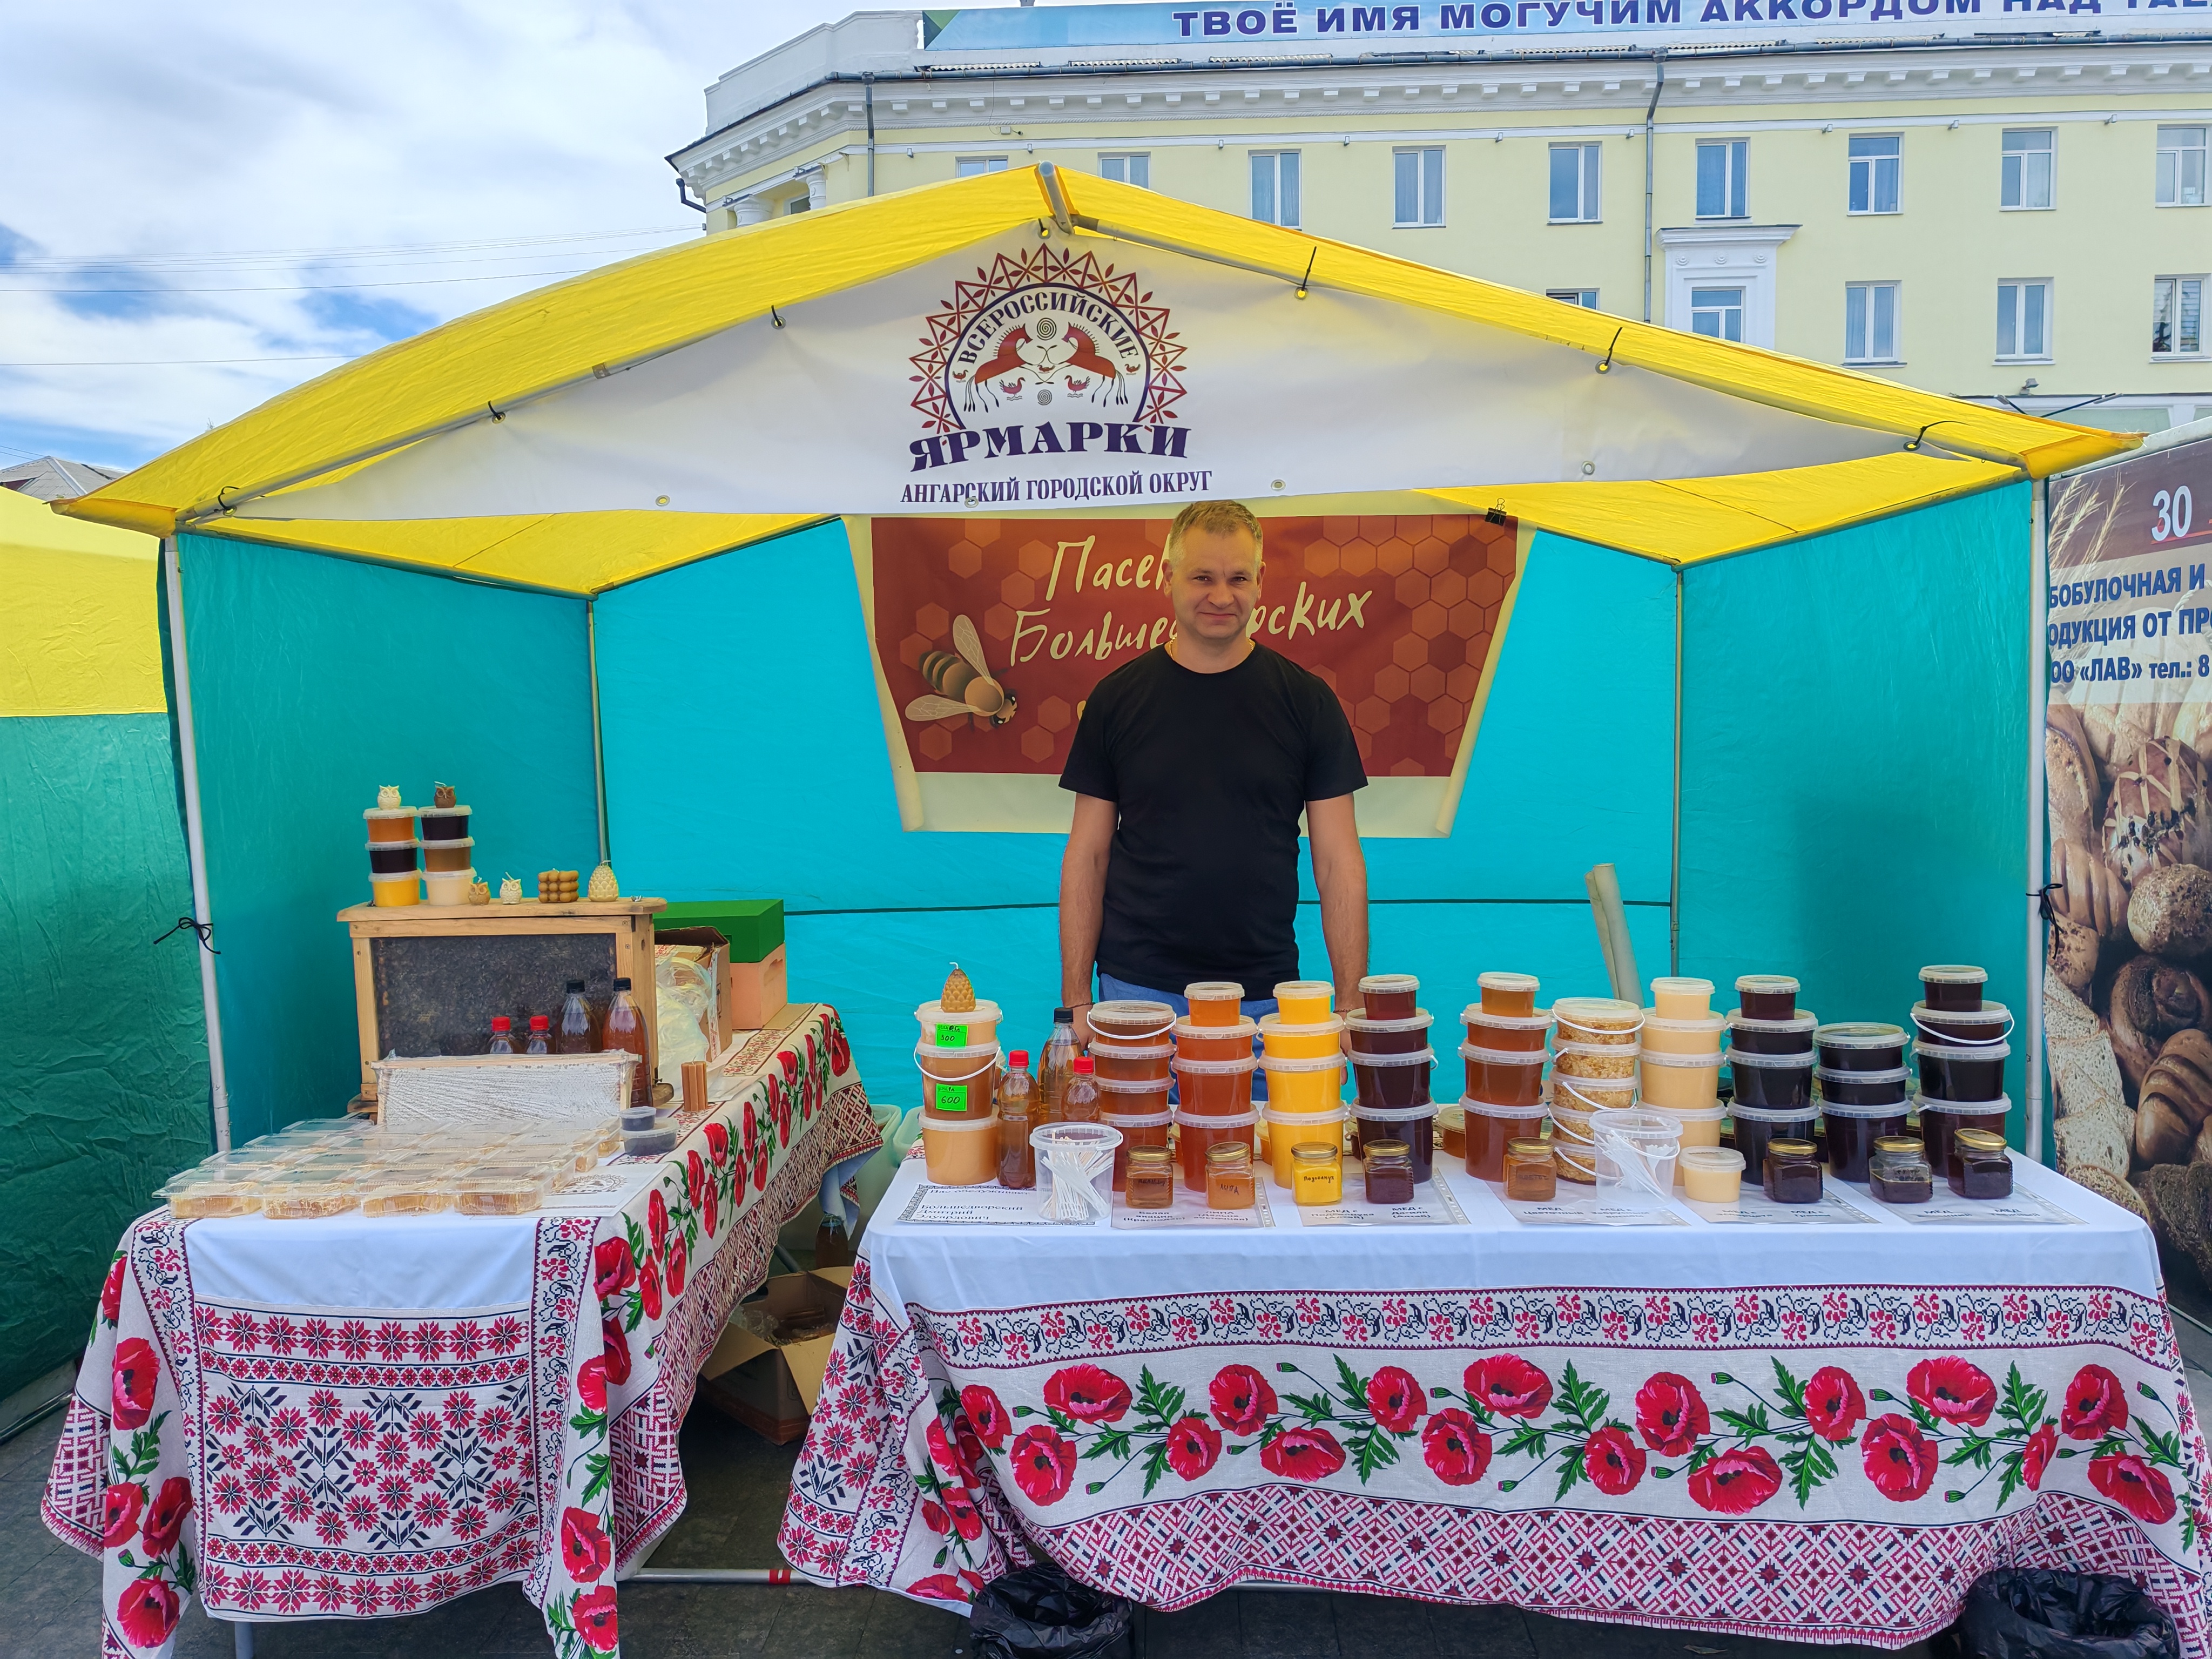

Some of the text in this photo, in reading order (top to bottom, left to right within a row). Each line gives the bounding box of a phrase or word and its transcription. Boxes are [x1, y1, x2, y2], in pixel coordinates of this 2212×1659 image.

[1173, 2, 1297, 37] ТВОЁ
[1316, 5, 1419, 32] ИМЯ
[1440, 0, 1681, 29] МОГУЧИМ
[1699, 0, 1980, 22] АККОРДОМ
[957, 291, 1139, 365] ВСЕРОССИЙСКИЕ
[909, 421, 1192, 472] ЯРМАРКИ
[900, 470, 1212, 503] АНГАРСКИЙ ГОРОДСКОЙ ОКРУГ
[2151, 485, 2192, 541] 30
[2189, 563, 2205, 590] И
[2142, 611, 2171, 638] ОТ
[2179, 608, 2212, 635] ПР
[2080, 656, 2142, 682] «ЛАВ»
[2149, 660, 2192, 679] тел.:
[2198, 655, 2209, 677] 8
[941, 1096, 960, 1104] 600
